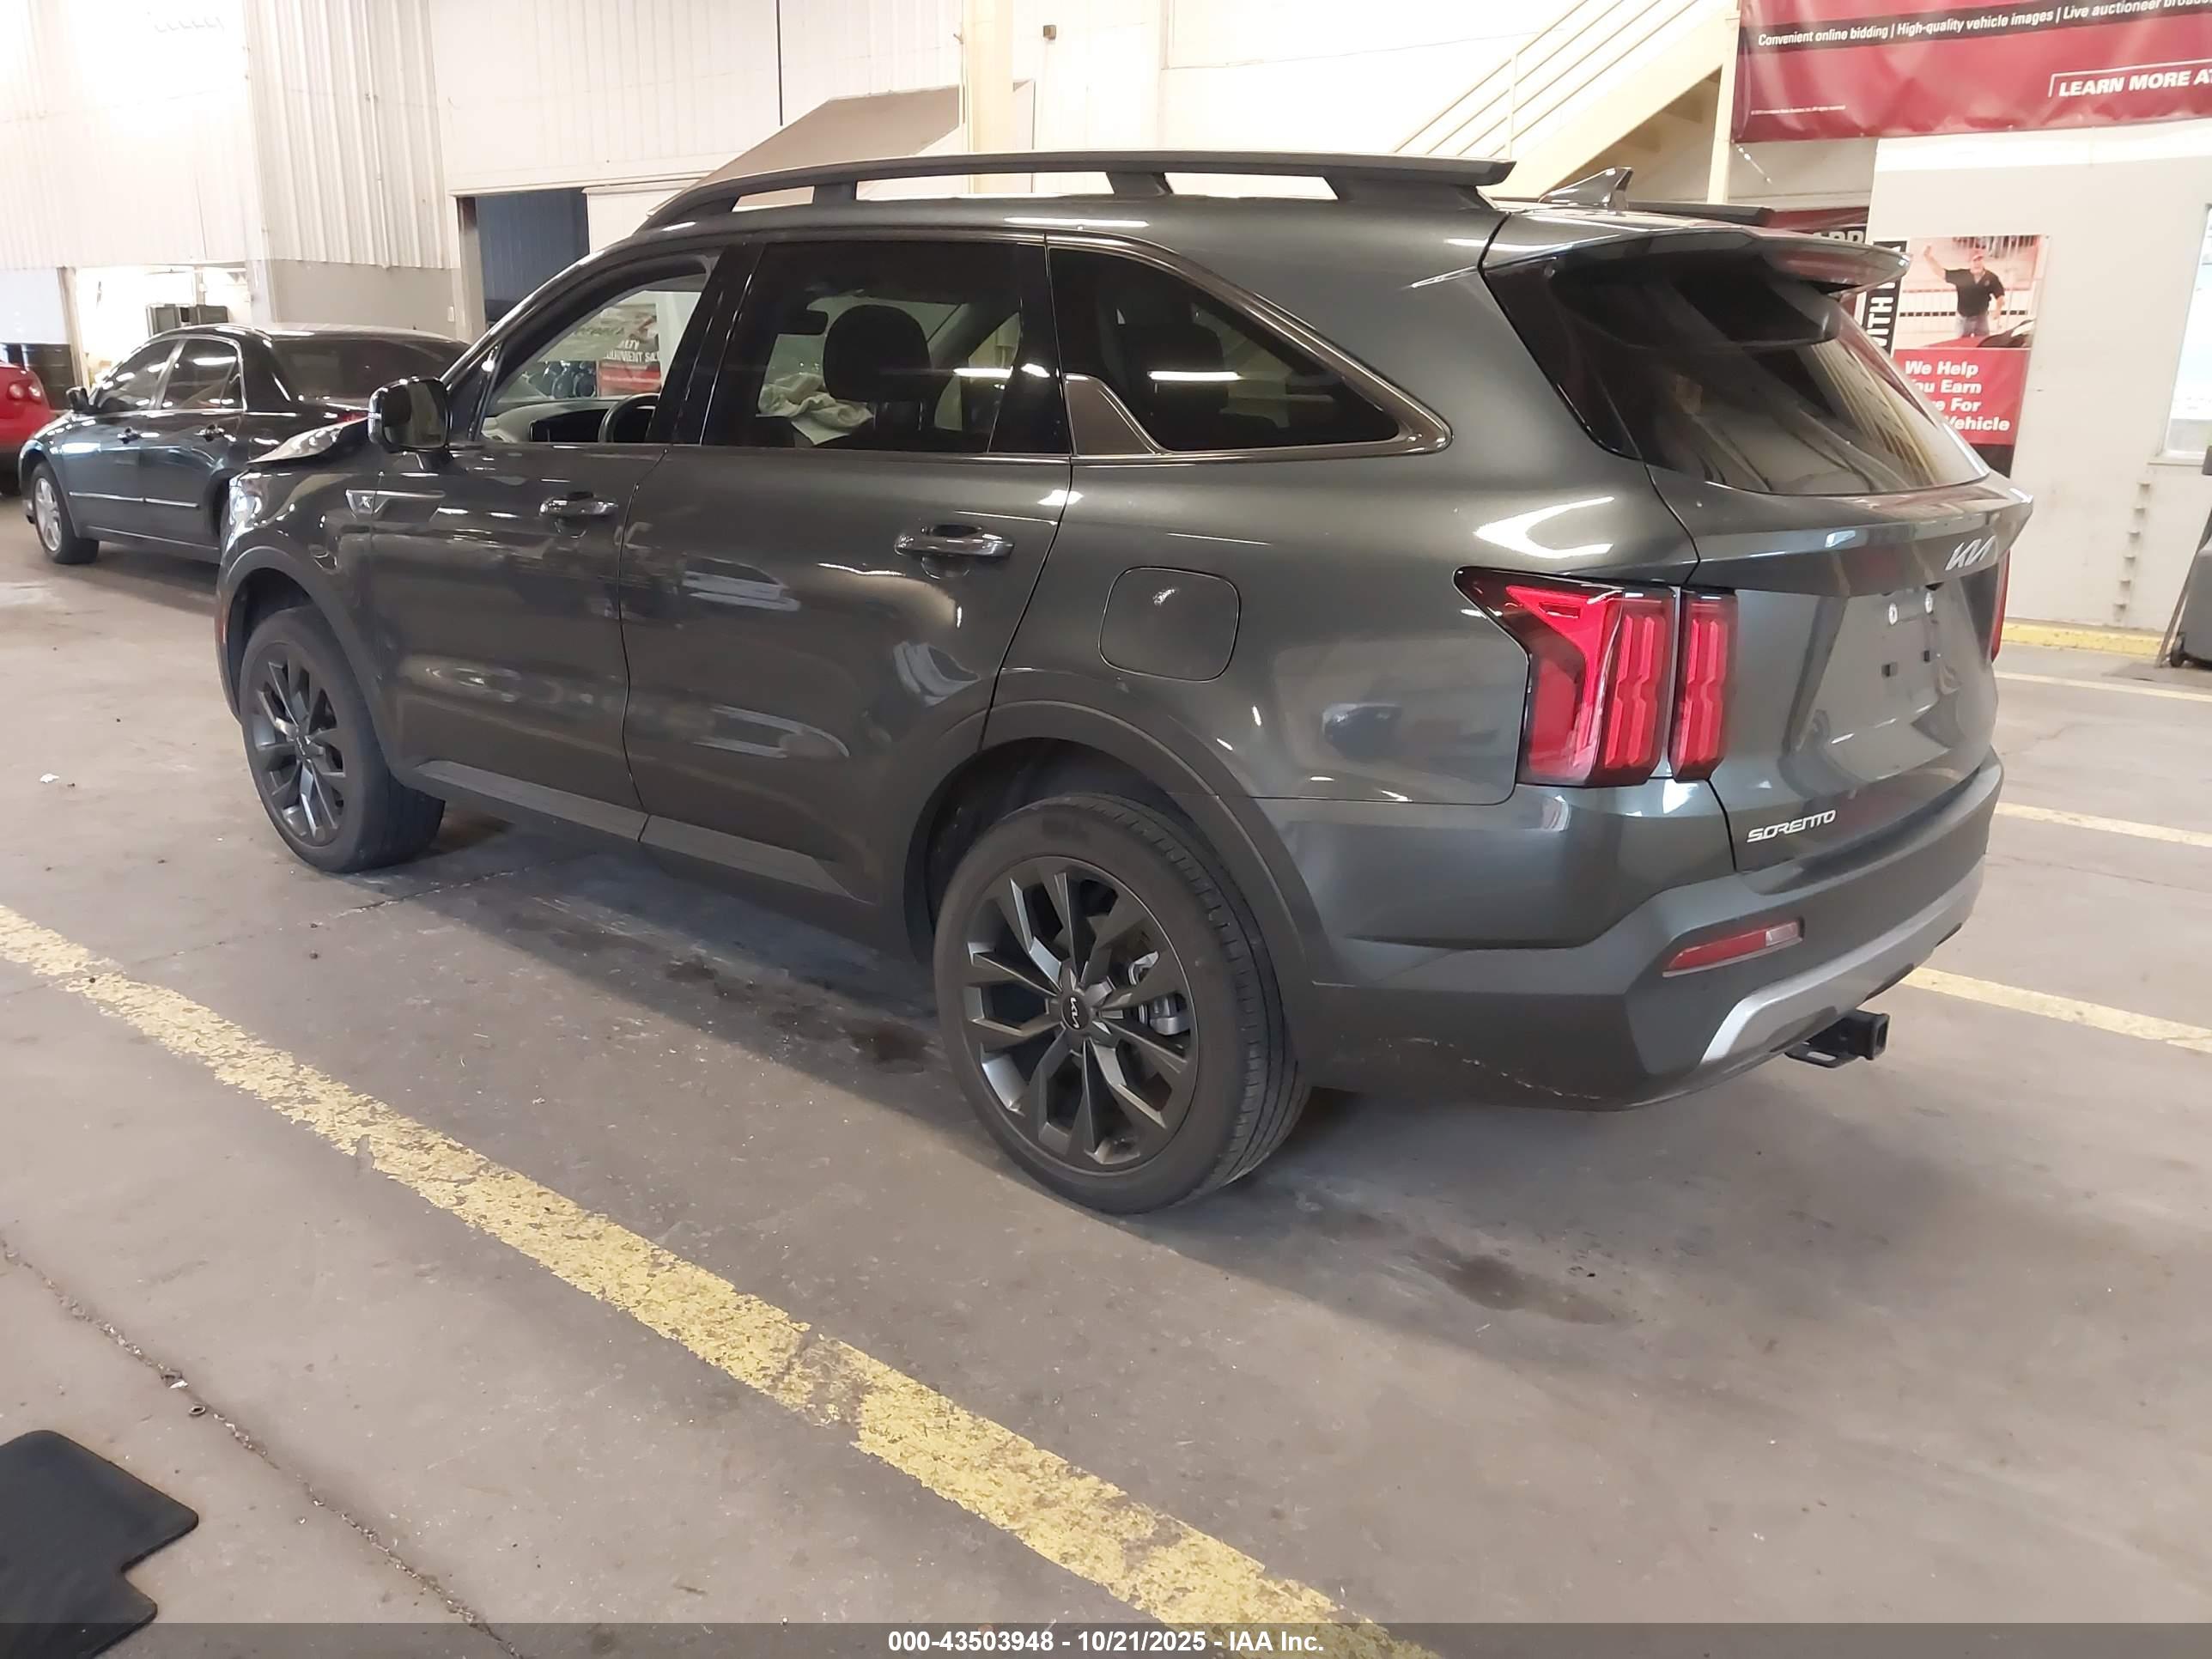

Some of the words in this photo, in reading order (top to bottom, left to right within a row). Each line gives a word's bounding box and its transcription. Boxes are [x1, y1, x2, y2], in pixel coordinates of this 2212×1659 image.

[1758, 30, 1814, 46] Convenient
[1814, 28, 1848, 43] online
[1850, 26, 1889, 41] bidding
[1897, 17, 1966, 37] High-quality
[1966, 15, 2008, 30] vehicle
[2010, 11, 2053, 27] images
[2063, 4, 2089, 21] Live
[2092, 0, 2160, 16] auctioneer
[2058, 76, 2125, 98] LEARN
[2129, 70, 2192, 91] MORE
[1905, 360, 1932, 375] We
[1936, 360, 1979, 378] Help
[1941, 379, 1983, 394] Earn
[1950, 398, 1982, 412] For
[1746, 809, 1837, 843] SORENTO
